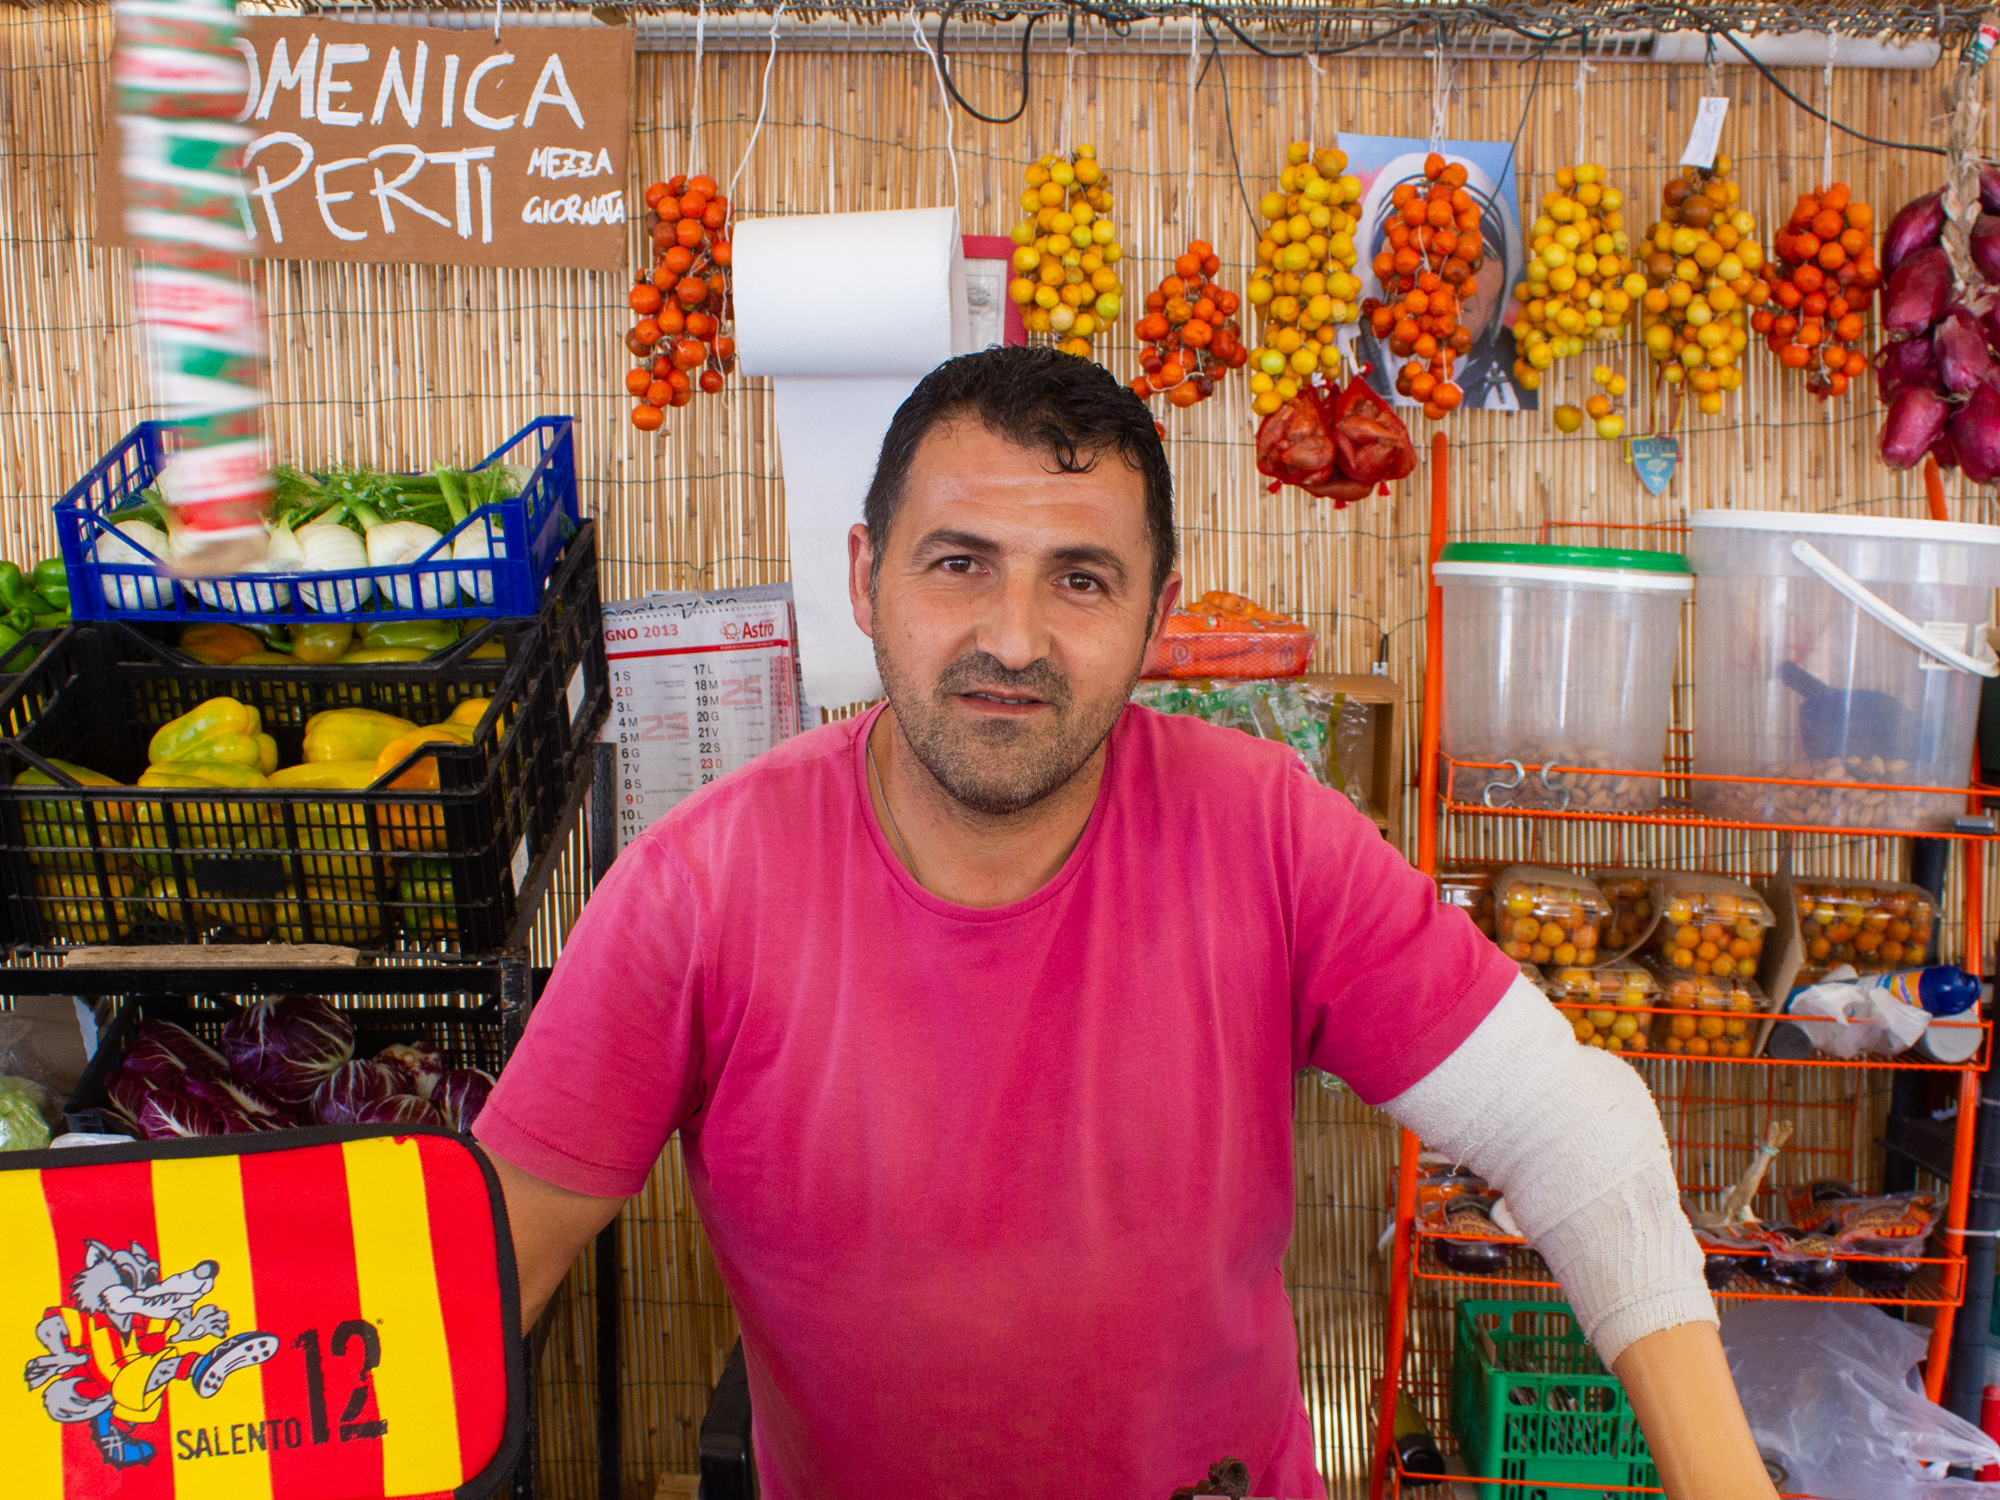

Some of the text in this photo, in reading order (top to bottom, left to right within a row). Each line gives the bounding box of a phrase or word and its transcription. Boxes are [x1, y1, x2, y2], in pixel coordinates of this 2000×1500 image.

[526, 146, 614, 181] MEZZA
[521, 190, 626, 226] GIORNATA
[605, 623, 679, 642] GNO 2013
[742, 620, 775, 640] Astro
[693, 664, 705, 675] 17
[707, 664, 714, 675] L
[614, 670, 631, 682] 1 S
[694, 679, 707, 691] 18
[708, 680, 719, 690] M
[615, 686, 634, 698] 2 D
[720, 676, 763, 707] 25
[616, 701, 634, 713] 3 L
[696, 695, 708, 707] 19
[709, 695, 719, 706] M
[618, 717, 639, 728] 4 M
[696, 710, 720, 723] 20 G
[640, 712, 690, 742] 23
[697, 726, 710, 738] 21
[711, 727, 719, 737] V
[619, 732, 640, 743] 5 M
[621, 747, 640, 759] 6 G
[699, 742, 712, 754] 22
[713, 742, 721, 753] S
[622, 763, 640, 774] 7 V
[700, 758, 723, 769] 23 D
[624, 778, 642, 790] 8 S
[625, 793, 644, 805] 9 D
[620, 809, 645, 821] 10 L
[621, 825, 635, 836] 11
[290, 1318, 388, 1446] 12
[176, 1417, 301, 1461] SALENTO
